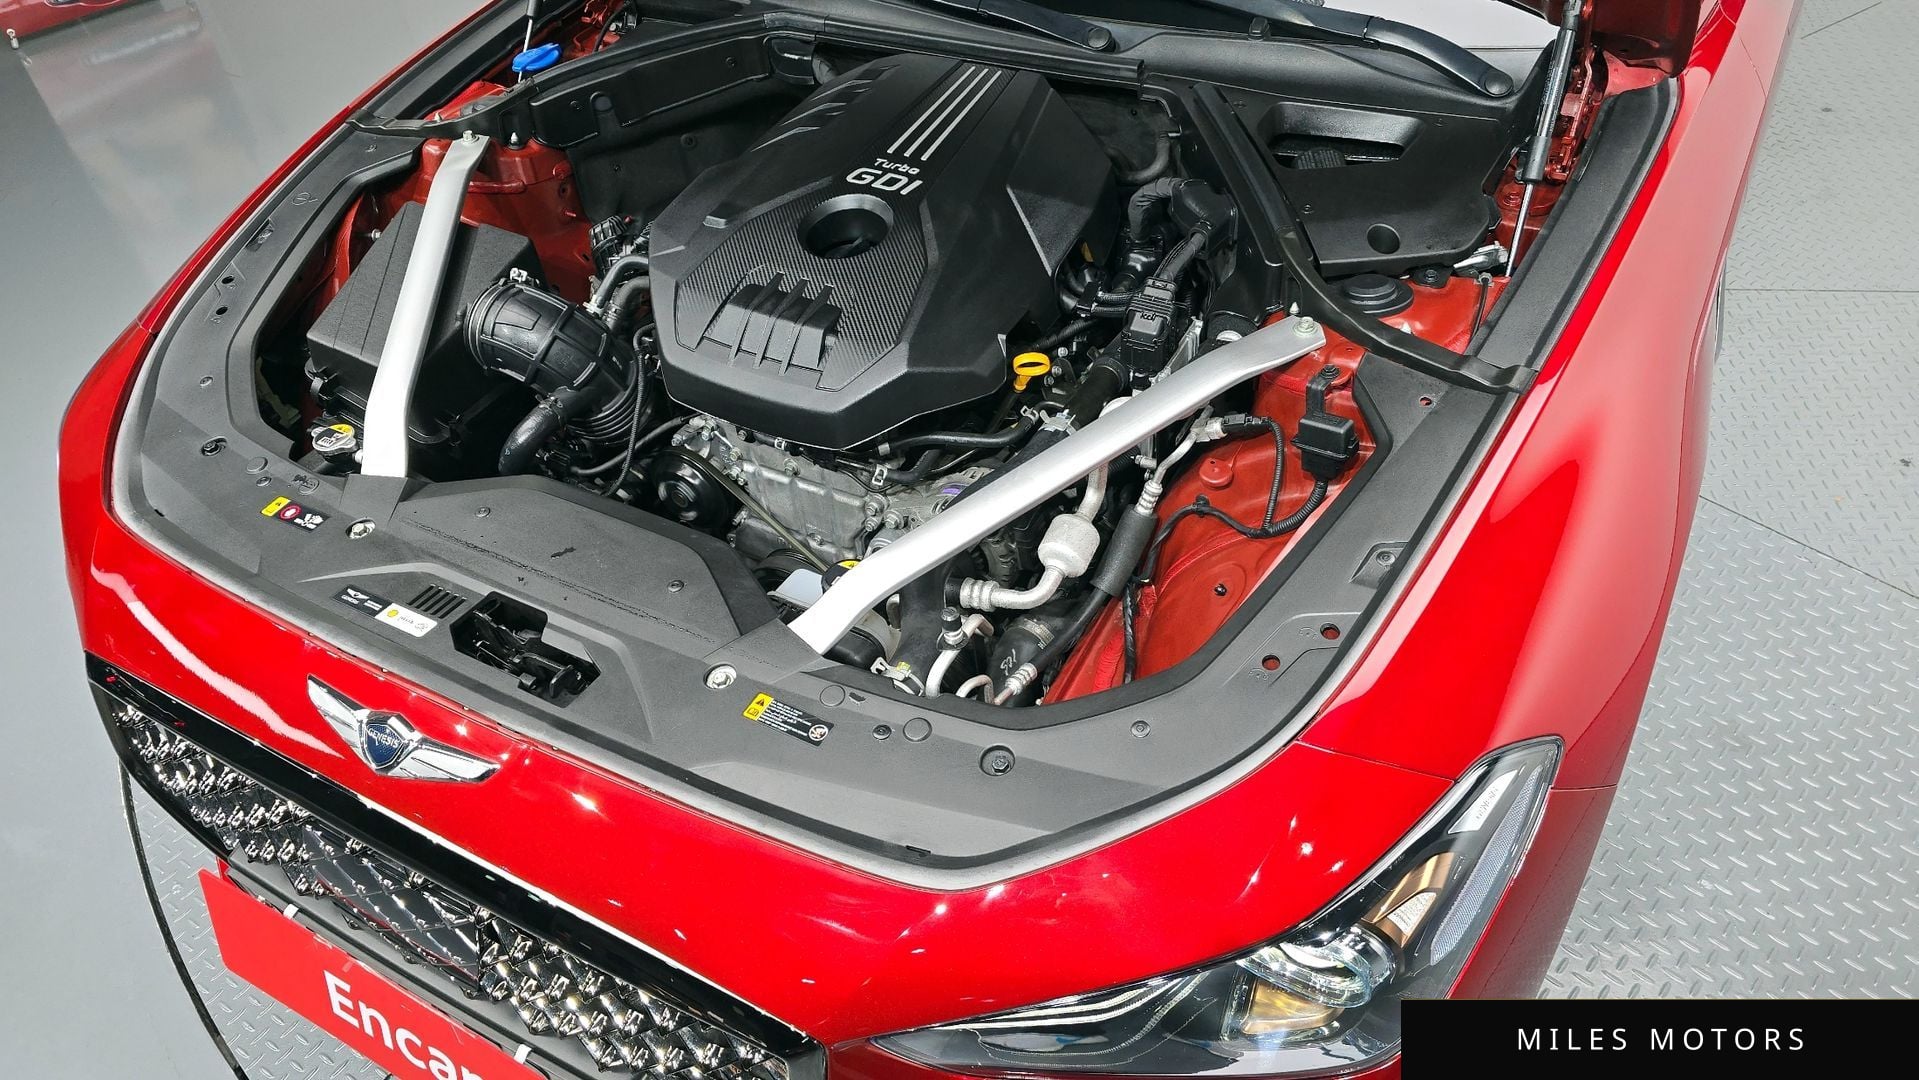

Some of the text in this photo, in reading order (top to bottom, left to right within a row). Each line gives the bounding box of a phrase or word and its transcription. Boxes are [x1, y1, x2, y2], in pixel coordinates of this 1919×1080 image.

[874, 158, 920, 175] Turbo
[845, 167, 923, 195] GDI
[368, 728, 400, 749] GENESIS
